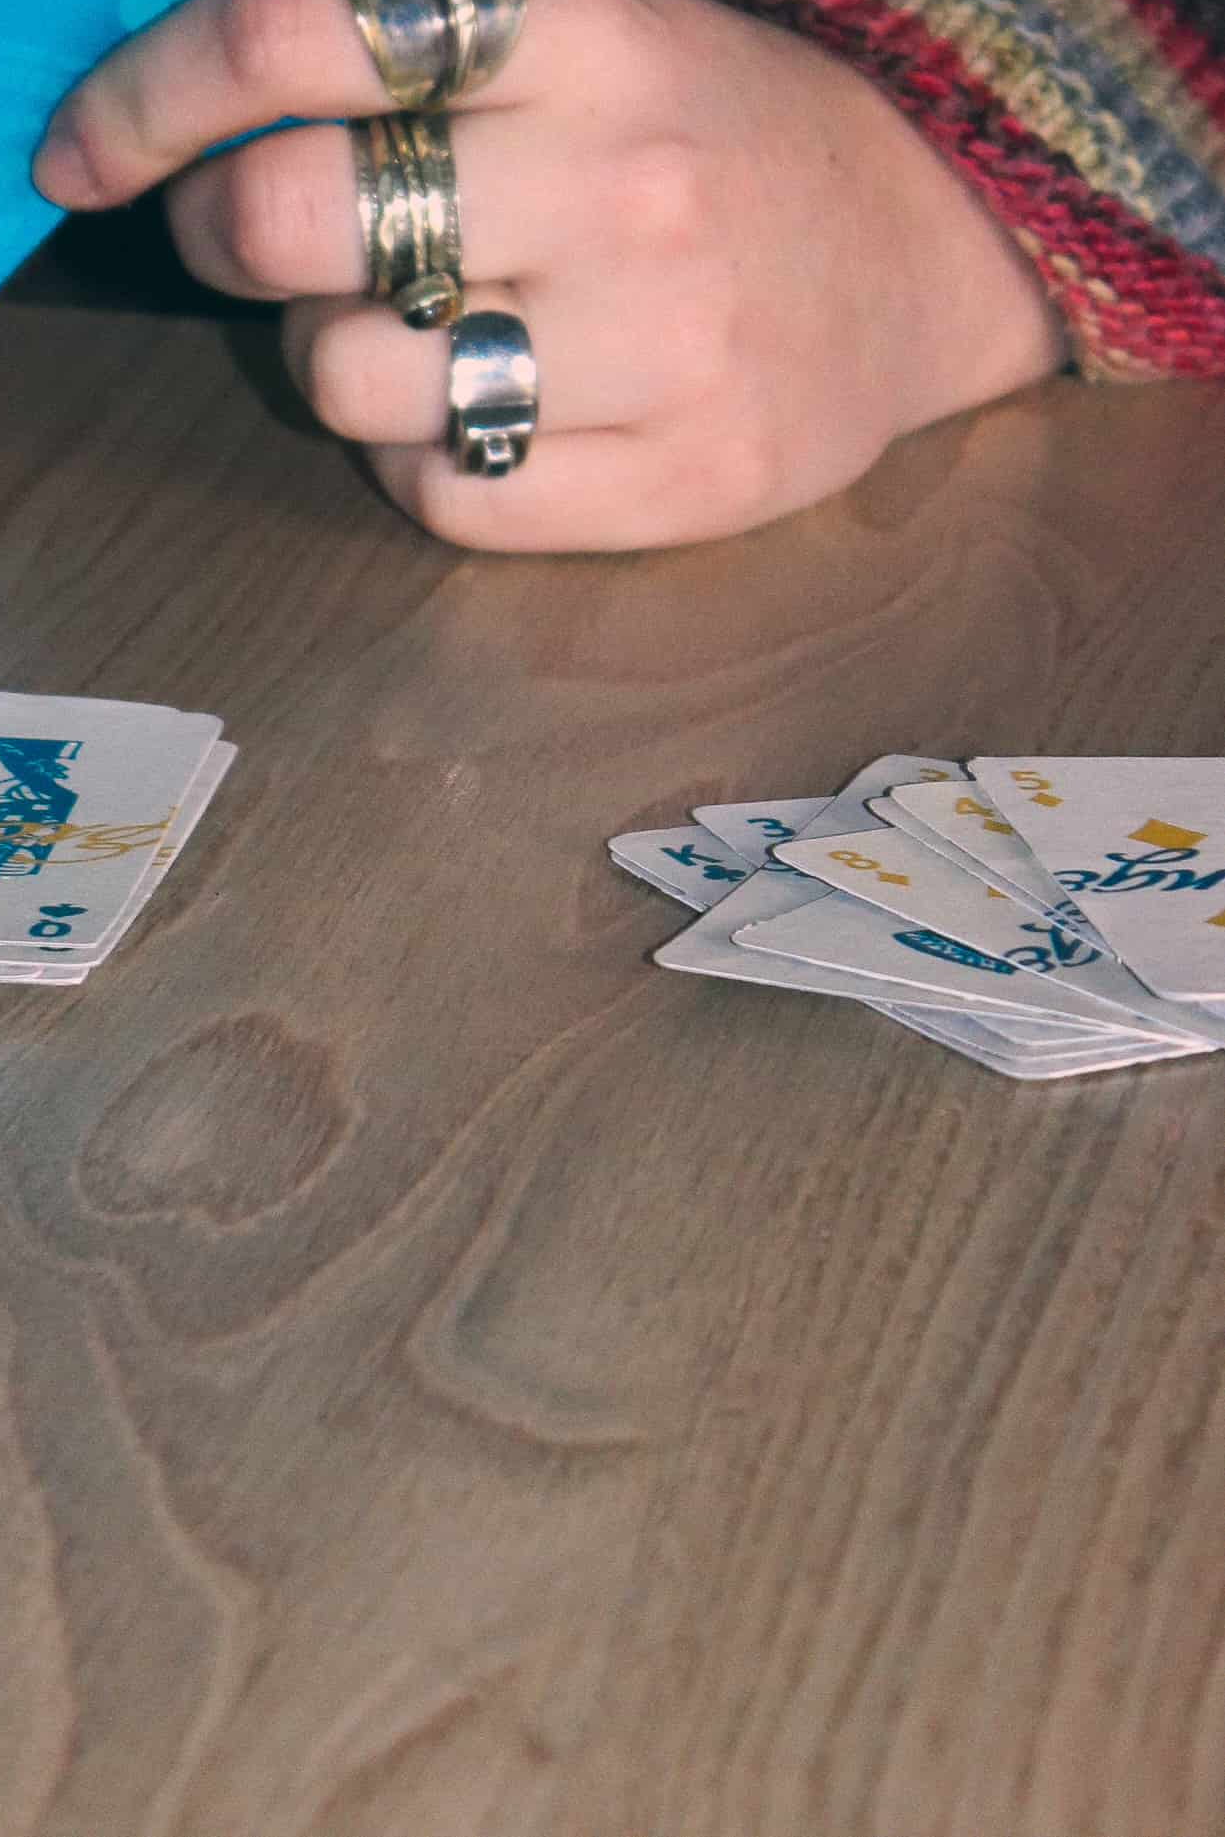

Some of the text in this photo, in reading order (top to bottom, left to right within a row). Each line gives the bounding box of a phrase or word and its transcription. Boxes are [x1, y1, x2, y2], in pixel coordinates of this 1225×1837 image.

[1009, 770, 1051, 790] 5
[746, 817, 797, 838] 3
[660, 843, 723, 867] K
[828, 850, 882, 870] 8
